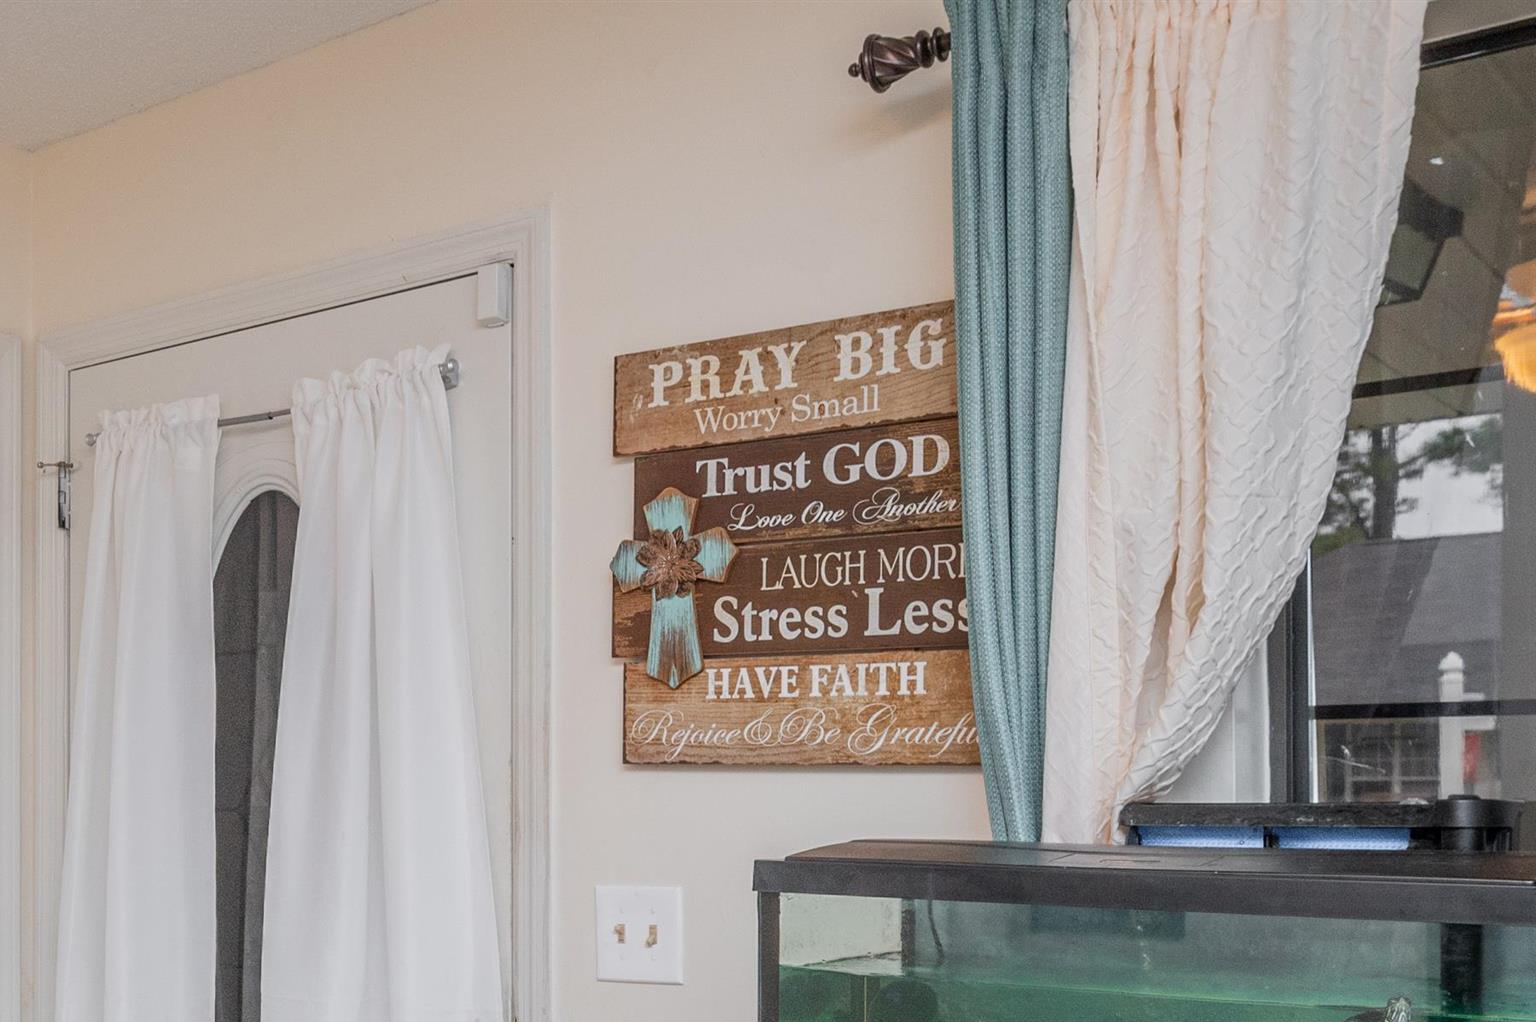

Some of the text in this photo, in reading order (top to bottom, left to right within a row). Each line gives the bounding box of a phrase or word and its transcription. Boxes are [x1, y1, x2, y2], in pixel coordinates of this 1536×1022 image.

[647, 318, 947, 408] PRAY BIG
[693, 384, 881, 435] Worry Small
[696, 434, 950, 498] Trust GOD
[727, 487, 960, 532] Love One Another
[760, 543, 966, 591] LAUGH MOR
[713, 595, 849, 644] Stress
[705, 661, 927, 700] HAVE FAITH
[629, 703, 979, 761] Rejoice & Be Gratefu
